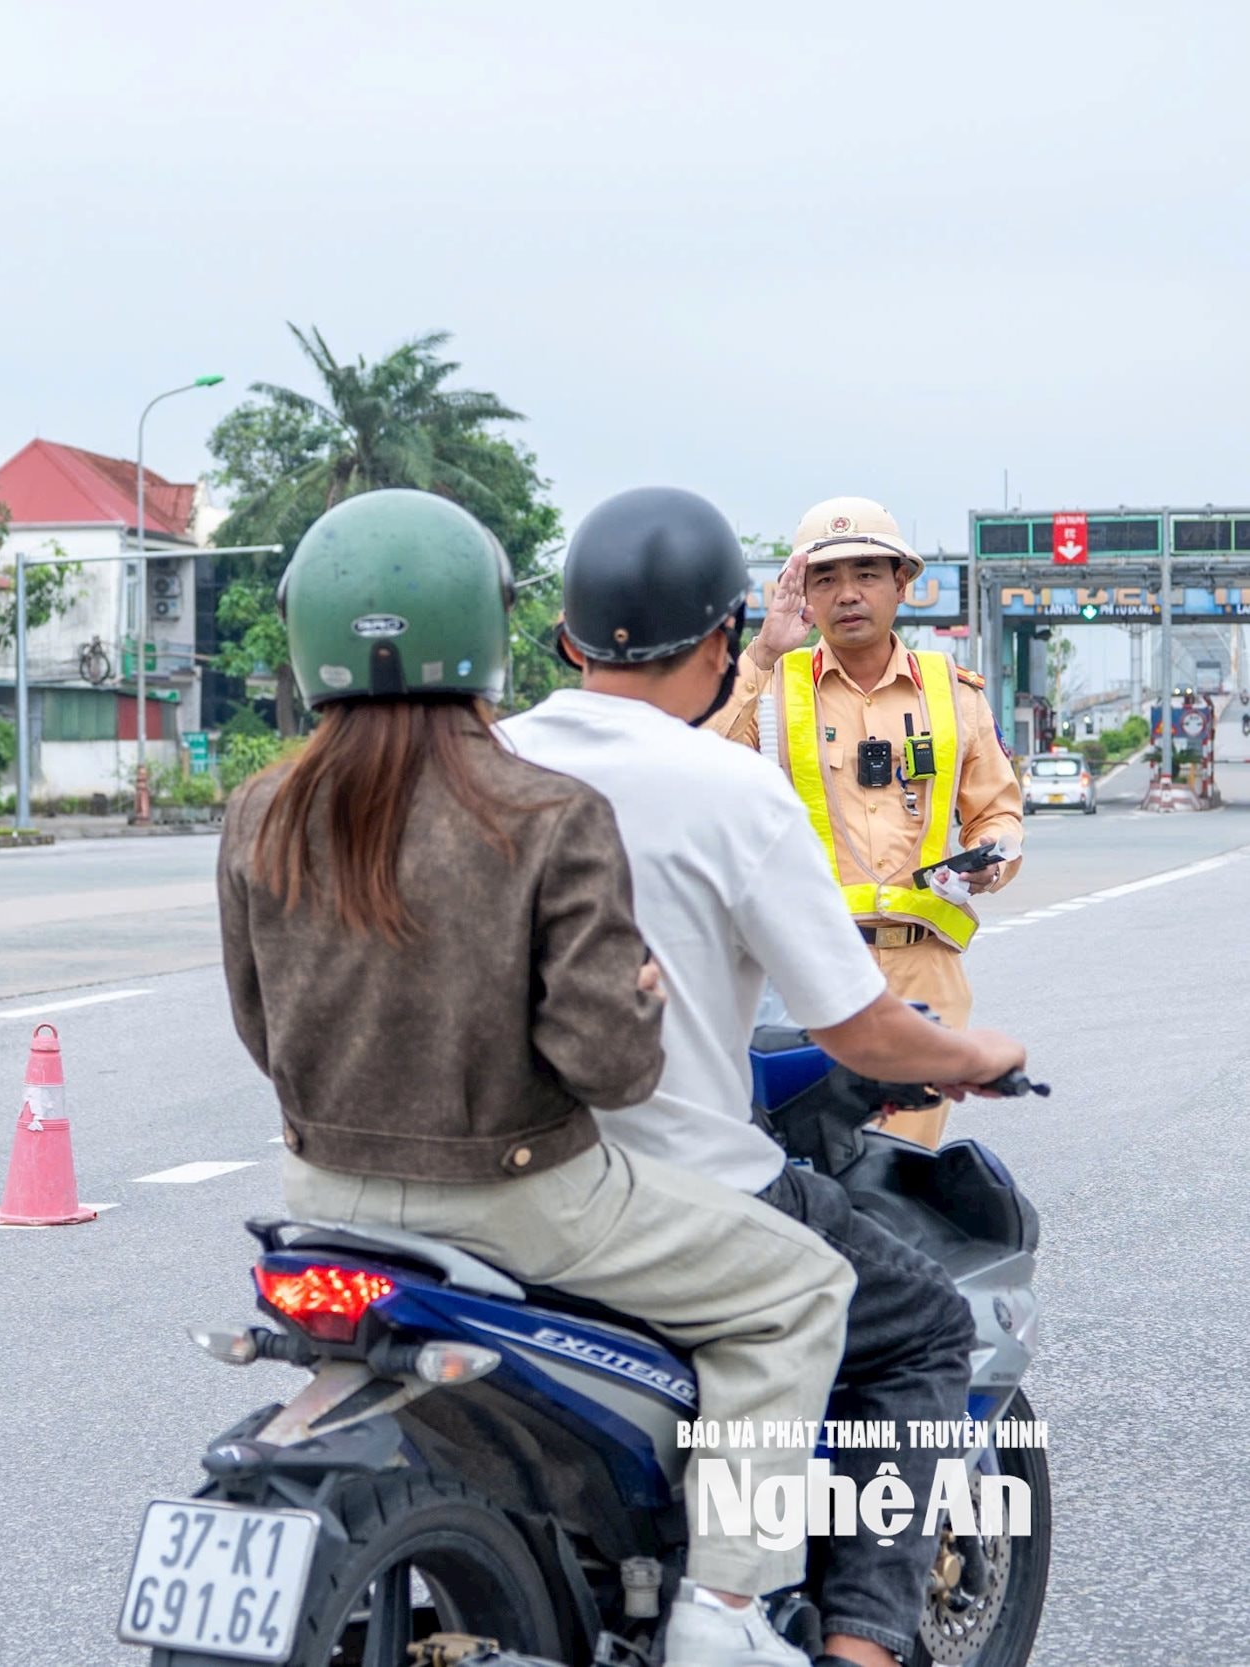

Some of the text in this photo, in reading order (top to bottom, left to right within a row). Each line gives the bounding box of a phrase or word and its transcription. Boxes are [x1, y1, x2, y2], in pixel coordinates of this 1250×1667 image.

[533, 1328, 671, 1388] EXCITER
[160, 1511, 285, 1579] 37-K1
[131, 1576, 281, 1648] 691.64
